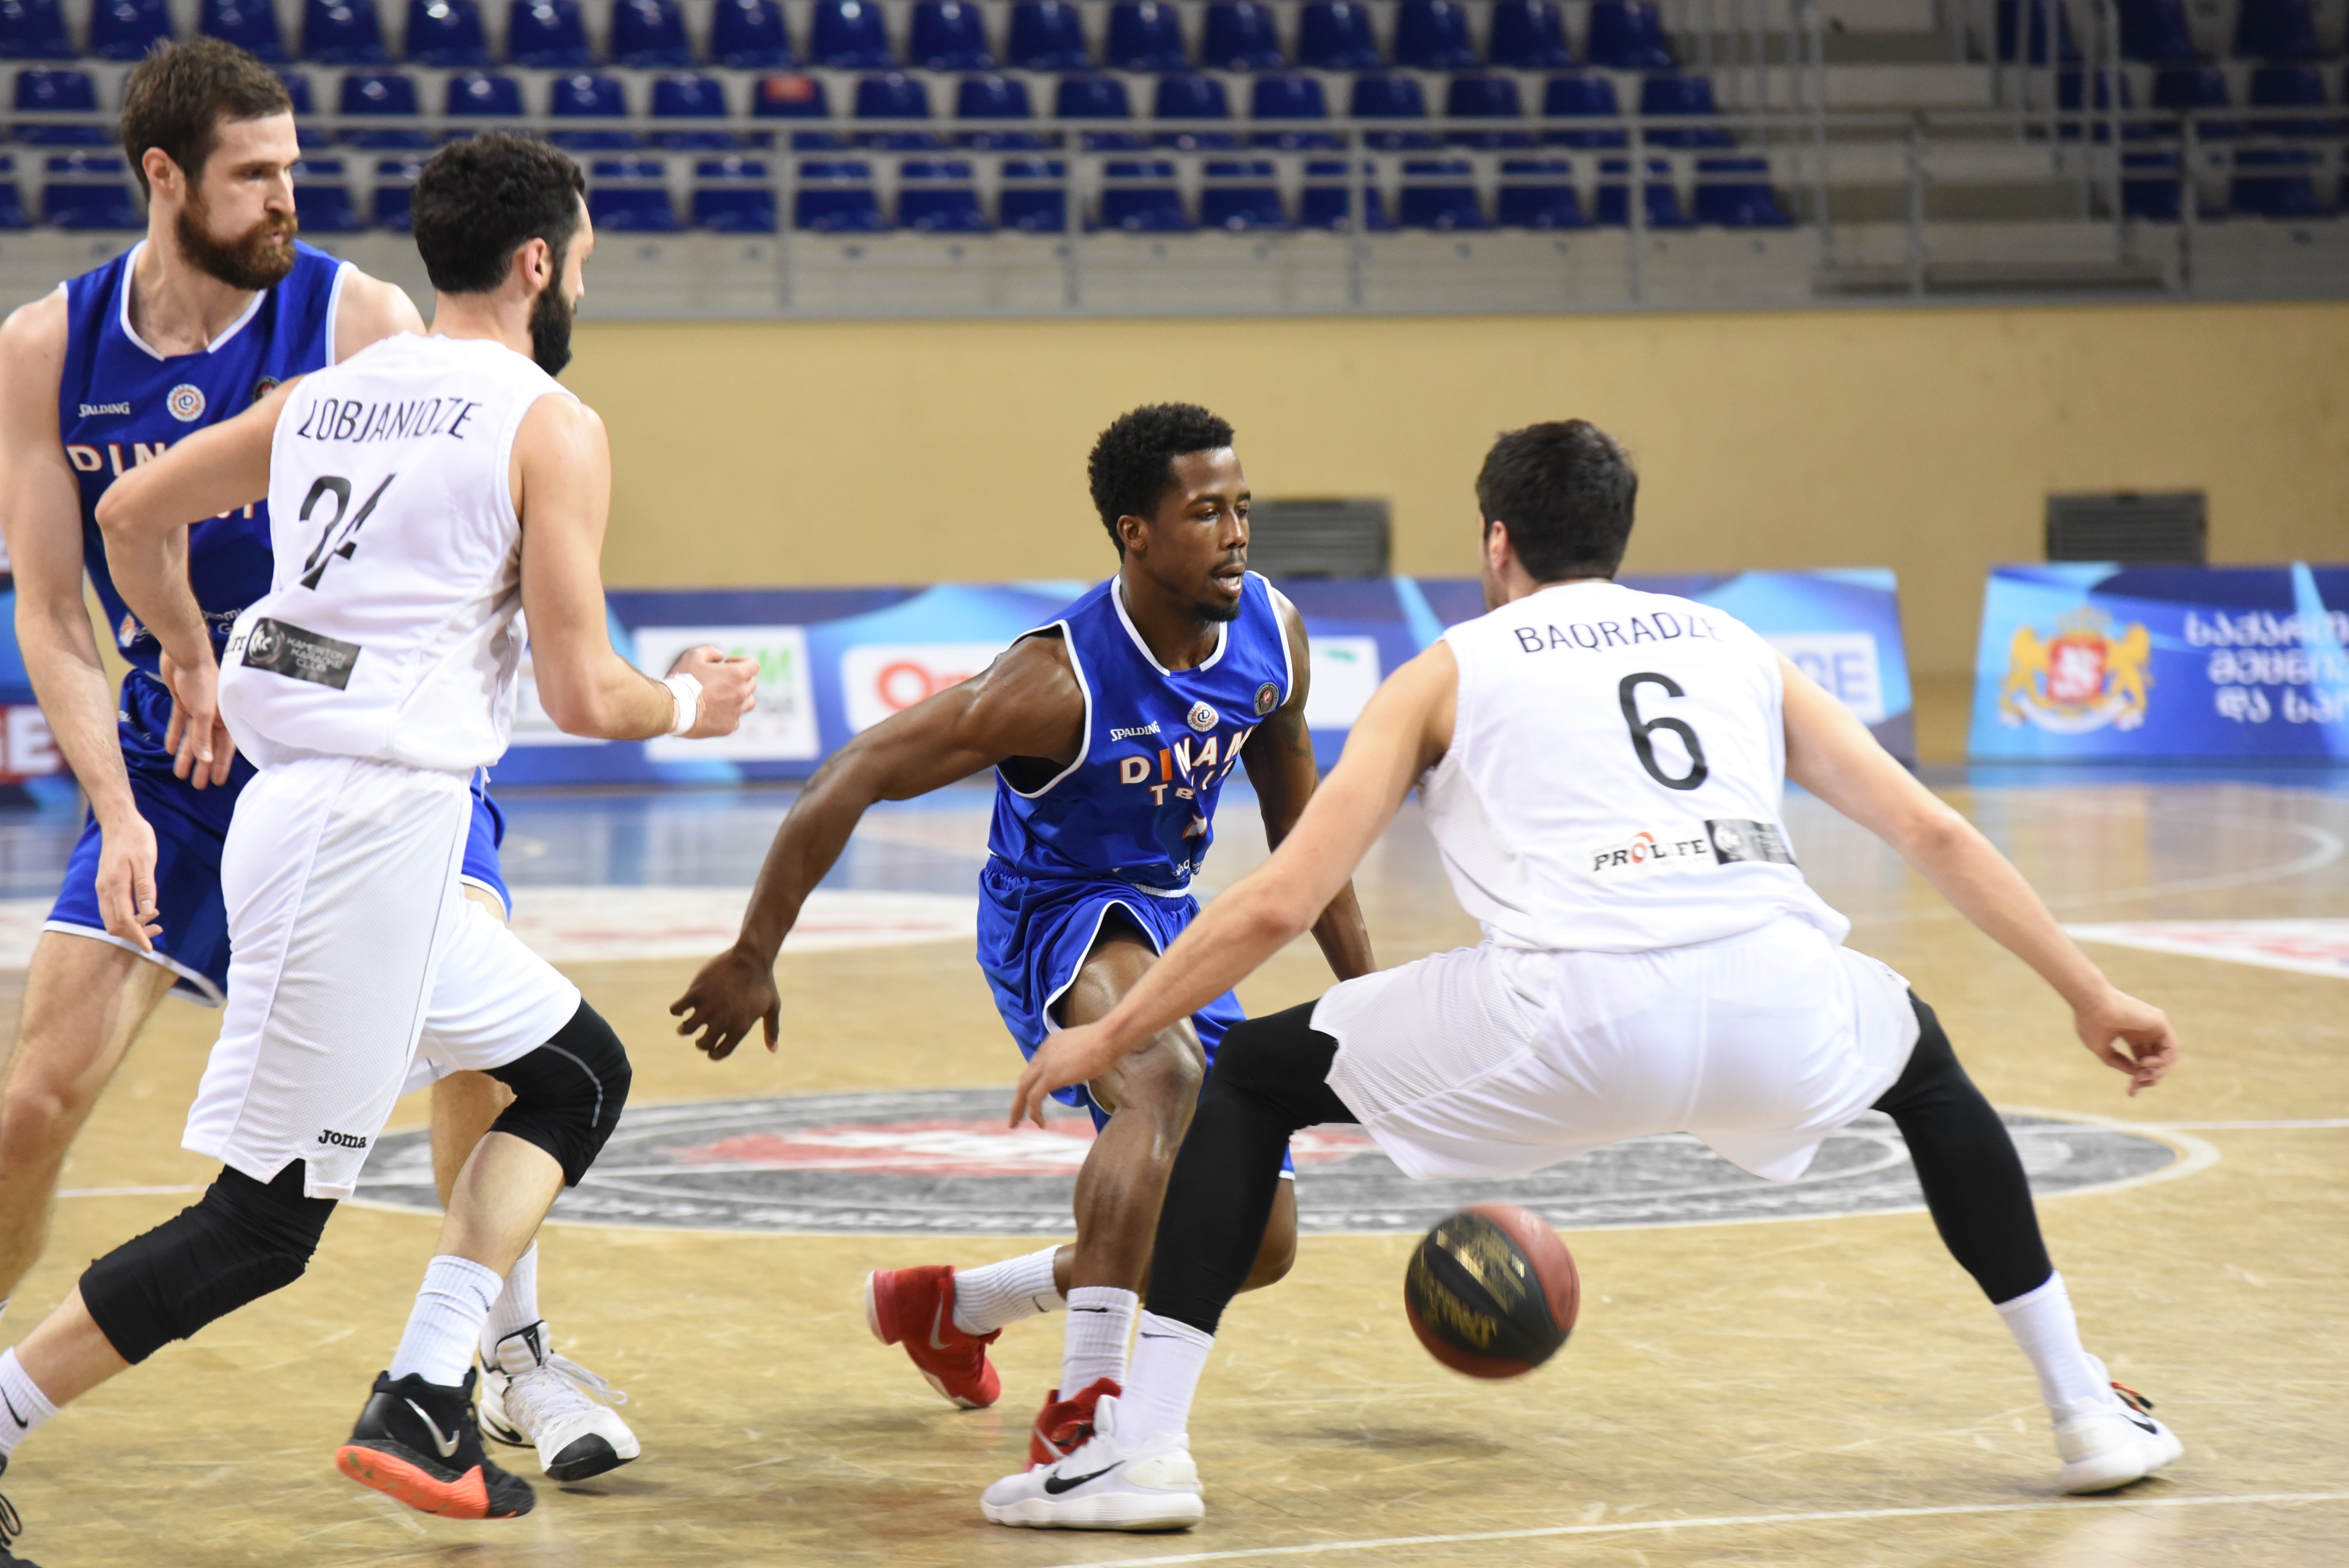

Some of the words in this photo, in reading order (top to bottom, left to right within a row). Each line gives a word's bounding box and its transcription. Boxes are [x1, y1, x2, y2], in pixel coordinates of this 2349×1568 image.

[78, 401, 131, 418] SALDING
[296, 397, 483, 443] LOBJANIDZE
[66, 442, 167, 477] DIN
[1110, 720, 1161, 742] SPALDING
[1619, 671, 1708, 791] 6
[1119, 725, 1256, 785] DINAM
[318, 1129, 367, 1149] Joma
